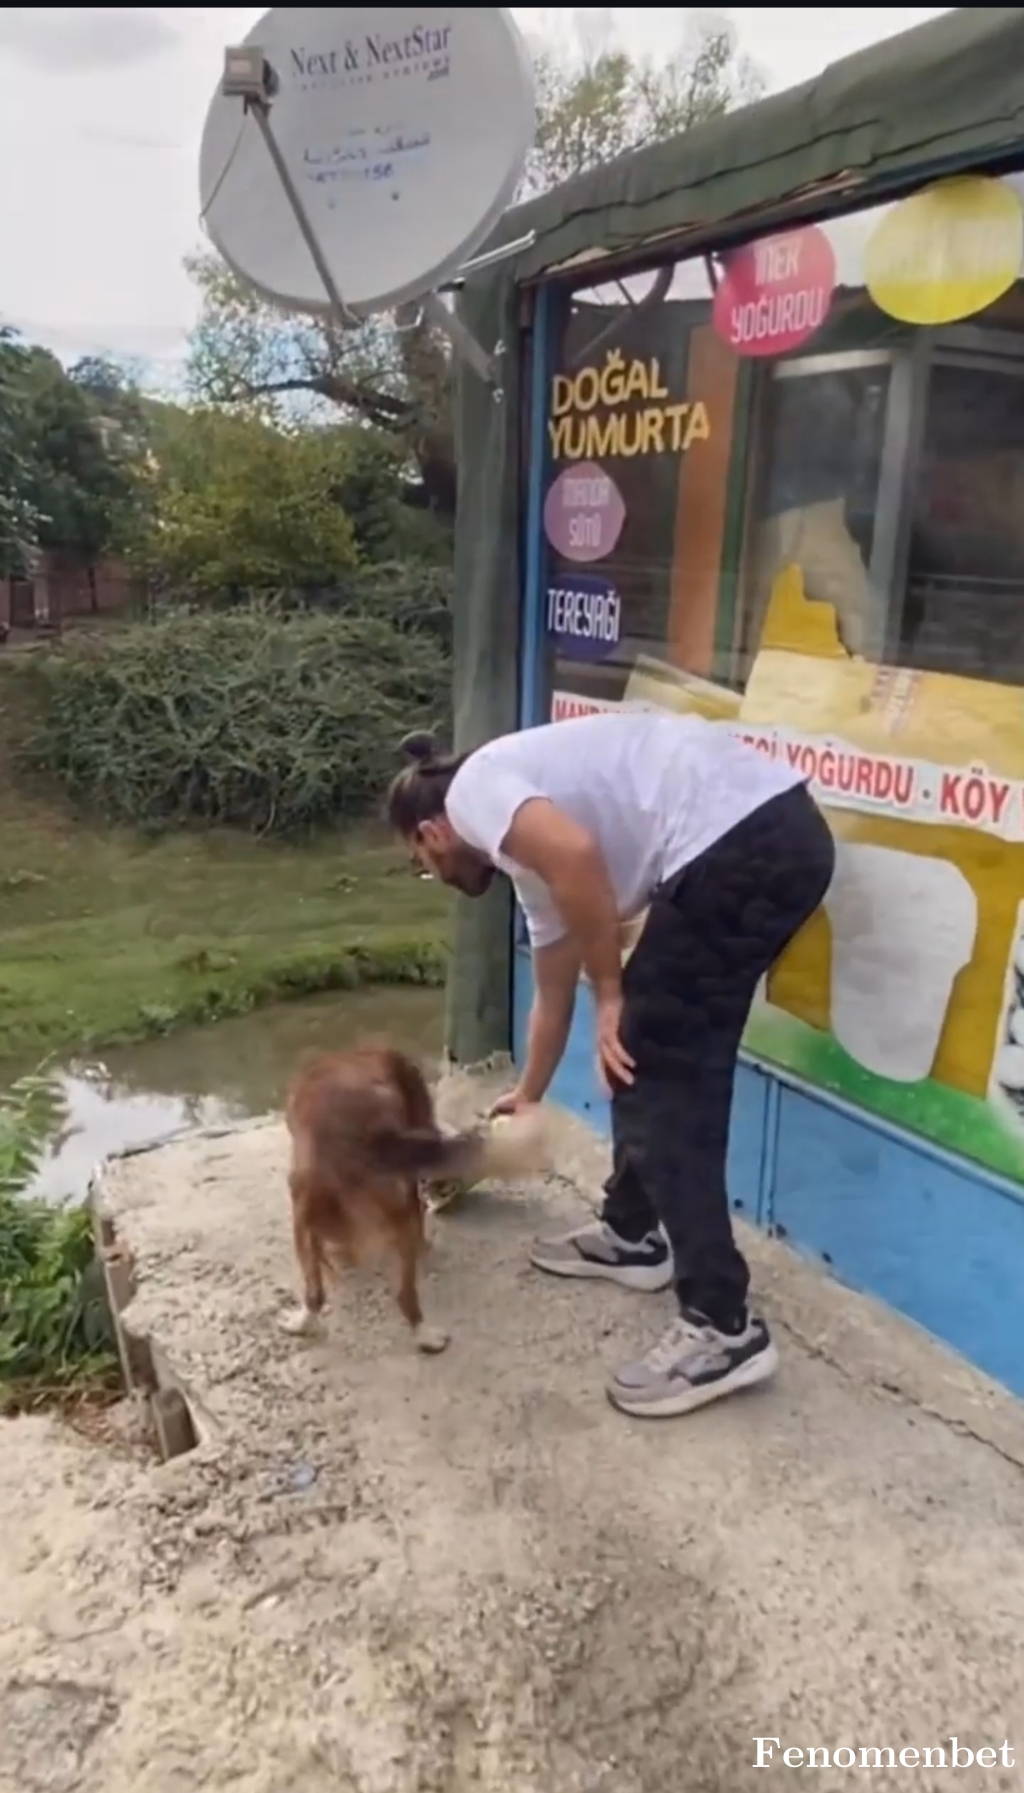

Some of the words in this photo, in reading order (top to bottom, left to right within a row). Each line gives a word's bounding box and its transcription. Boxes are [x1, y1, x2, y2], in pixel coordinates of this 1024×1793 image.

[291, 46, 337, 77] Next
[344, 39, 359, 71] &
[365, 24, 452, 67] NextStar
[730, 287, 823, 343] YOĞURDU
[552, 349, 668, 416] DOĞAL
[548, 401, 710, 459] YUMURTA
[547, 588, 621, 642] TEREYAĞI
[786, 741, 913, 804] YOĞURDU
[940, 766, 1010, 824] KÖY
